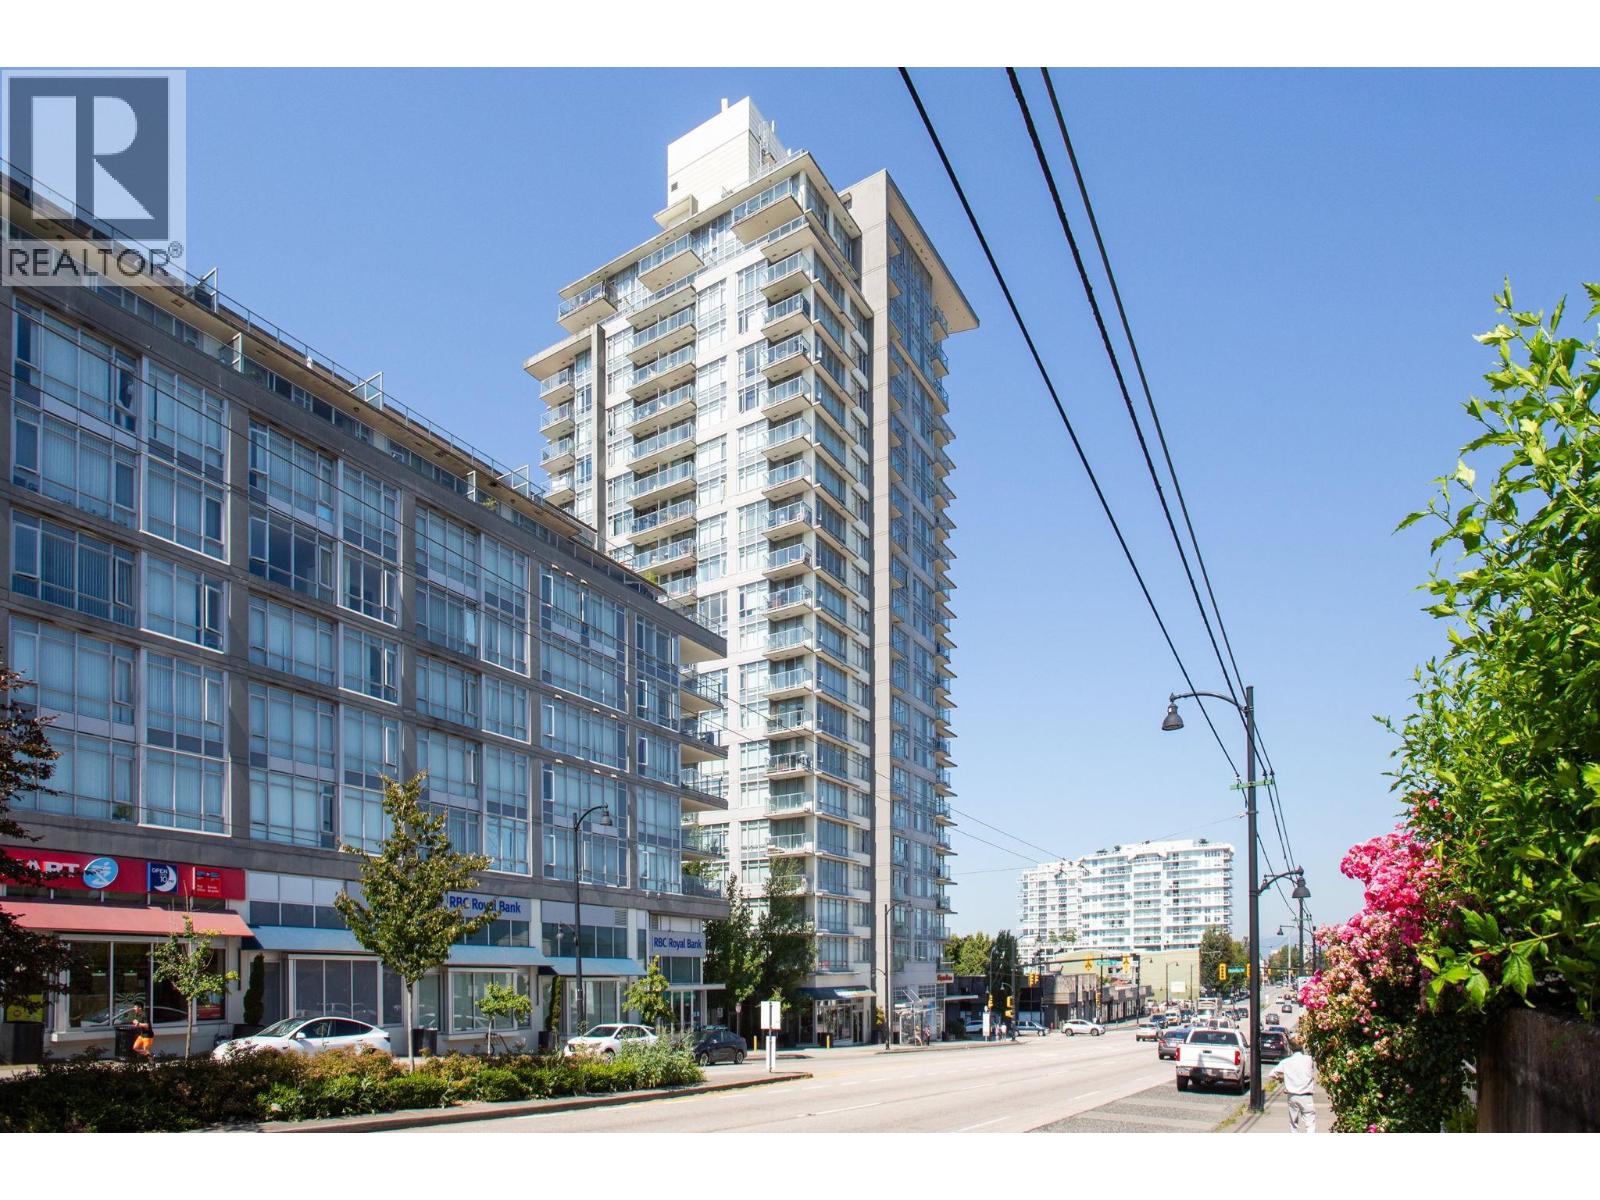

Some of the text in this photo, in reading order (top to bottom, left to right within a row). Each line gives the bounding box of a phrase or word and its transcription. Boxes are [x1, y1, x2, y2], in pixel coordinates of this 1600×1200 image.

[499, 900, 522, 913] Bank
[653, 936, 702, 950] RBC Royal Bank
